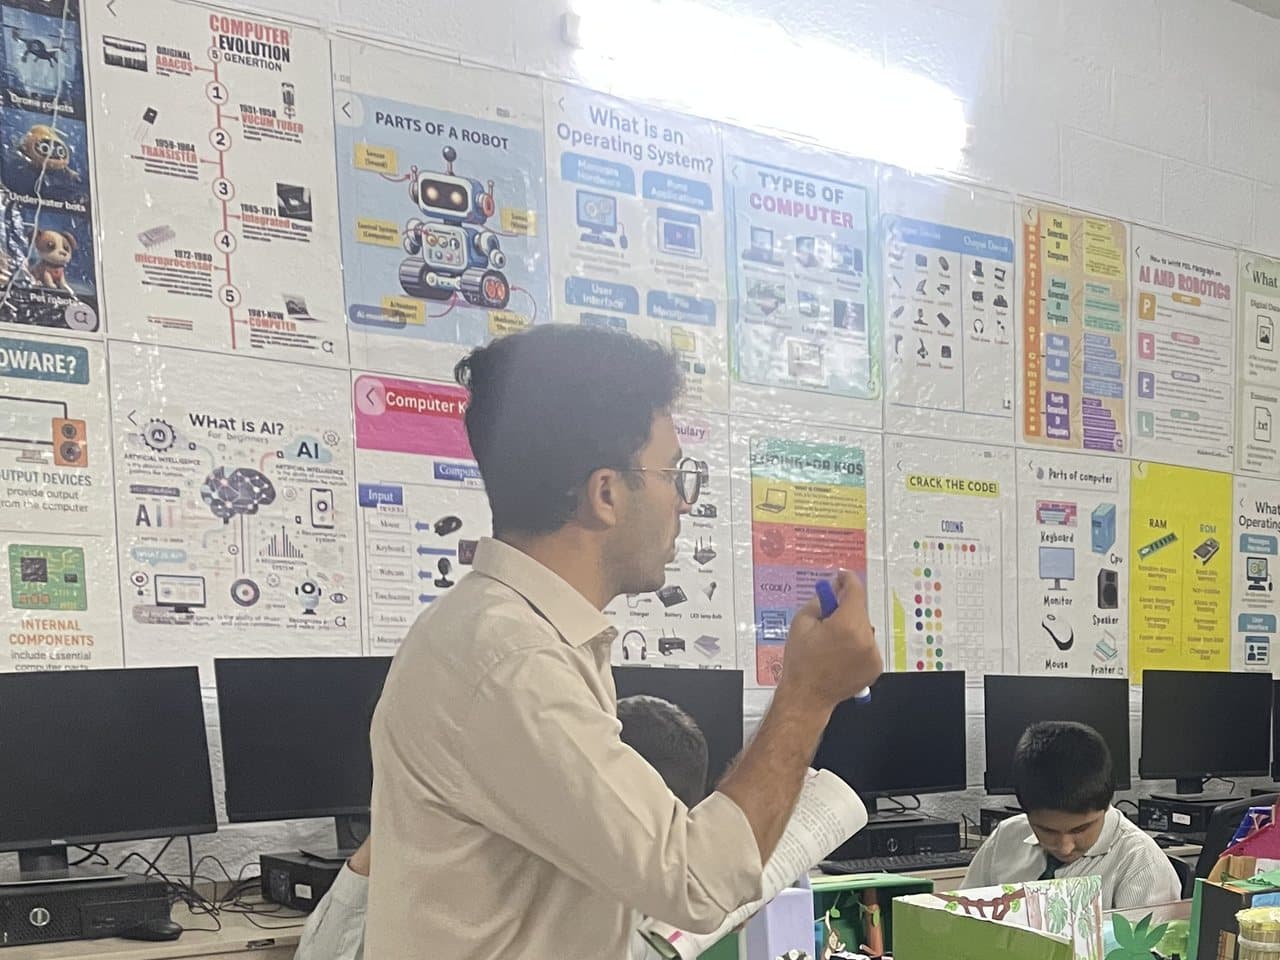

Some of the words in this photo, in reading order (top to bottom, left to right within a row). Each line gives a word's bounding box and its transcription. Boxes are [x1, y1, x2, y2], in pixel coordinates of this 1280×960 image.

[209, 14, 290, 45] COMPUTER
[219, 34, 290, 62] EVOLUTION
[156, 55, 193, 72] ABACUS
[224, 54, 282, 72] GENERTION
[213, 86, 222, 100] 1
[375, 111, 422, 133] PARTS
[426, 121, 444, 136] OF
[448, 126, 459, 140] A
[462, 128, 510, 150] ROBOT
[589, 105, 639, 135] What
[643, 118, 658, 138] is
[662, 127, 684, 146] an
[216, 132, 226, 146] 2
[557, 123, 643, 160] Operating
[647, 145, 714, 174] System?
[219, 182, 228, 196] 3
[758, 171, 817, 199] TYPES
[822, 186, 844, 204] OF
[65, 201, 86, 213] bots
[750, 192, 854, 229] COMPUTER
[220, 235, 231, 248] 4
[134, 253, 213, 271] microprocessor
[1140, 265, 1151, 283] AI
[1154, 268, 1175, 288] AND
[1178, 273, 1231, 301] ROBOTICS
[1252, 270, 1278, 290] What
[225, 289, 234, 303] 5
[1143, 298, 1151, 314] P
[249, 317, 297, 332] COMPUTER
[1143, 339, 1150, 353] E
[1143, 378, 1150, 393] E
[386, 391, 455, 413] Computer
[260, 421, 284, 436] AI?
[1143, 415, 1149, 432] L
[297, 441, 320, 459] AI
[42, 472, 92, 487] DEVICES
[1048, 467, 1067, 480] Parts
[1069, 470, 1077, 480] of
[1079, 472, 1113, 485] computer
[909, 475, 943, 489] CRACK
[945, 479, 965, 490] THE
[967, 481, 997, 494] CODE!
[7, 487, 44, 499] provide
[47, 490, 79, 500] output
[368, 489, 394, 502] Input
[42, 502, 89, 512] computer
[1255, 501, 1280, 516] What
[941, 520, 964, 533] CODING
[1149, 518, 1167, 530] RAM
[1040, 531, 1074, 544] Keyboard
[1110, 552, 1123, 565] Cpu
[1043, 595, 1072, 606] Monitor
[21, 619, 81, 631] INTERNAL
[1092, 614, 1119, 626] Speaker
[9, 633, 94, 647] COMPONENTS
[1045, 658, 1068, 670] Mouse
[1091, 664, 1116, 675] Printer
